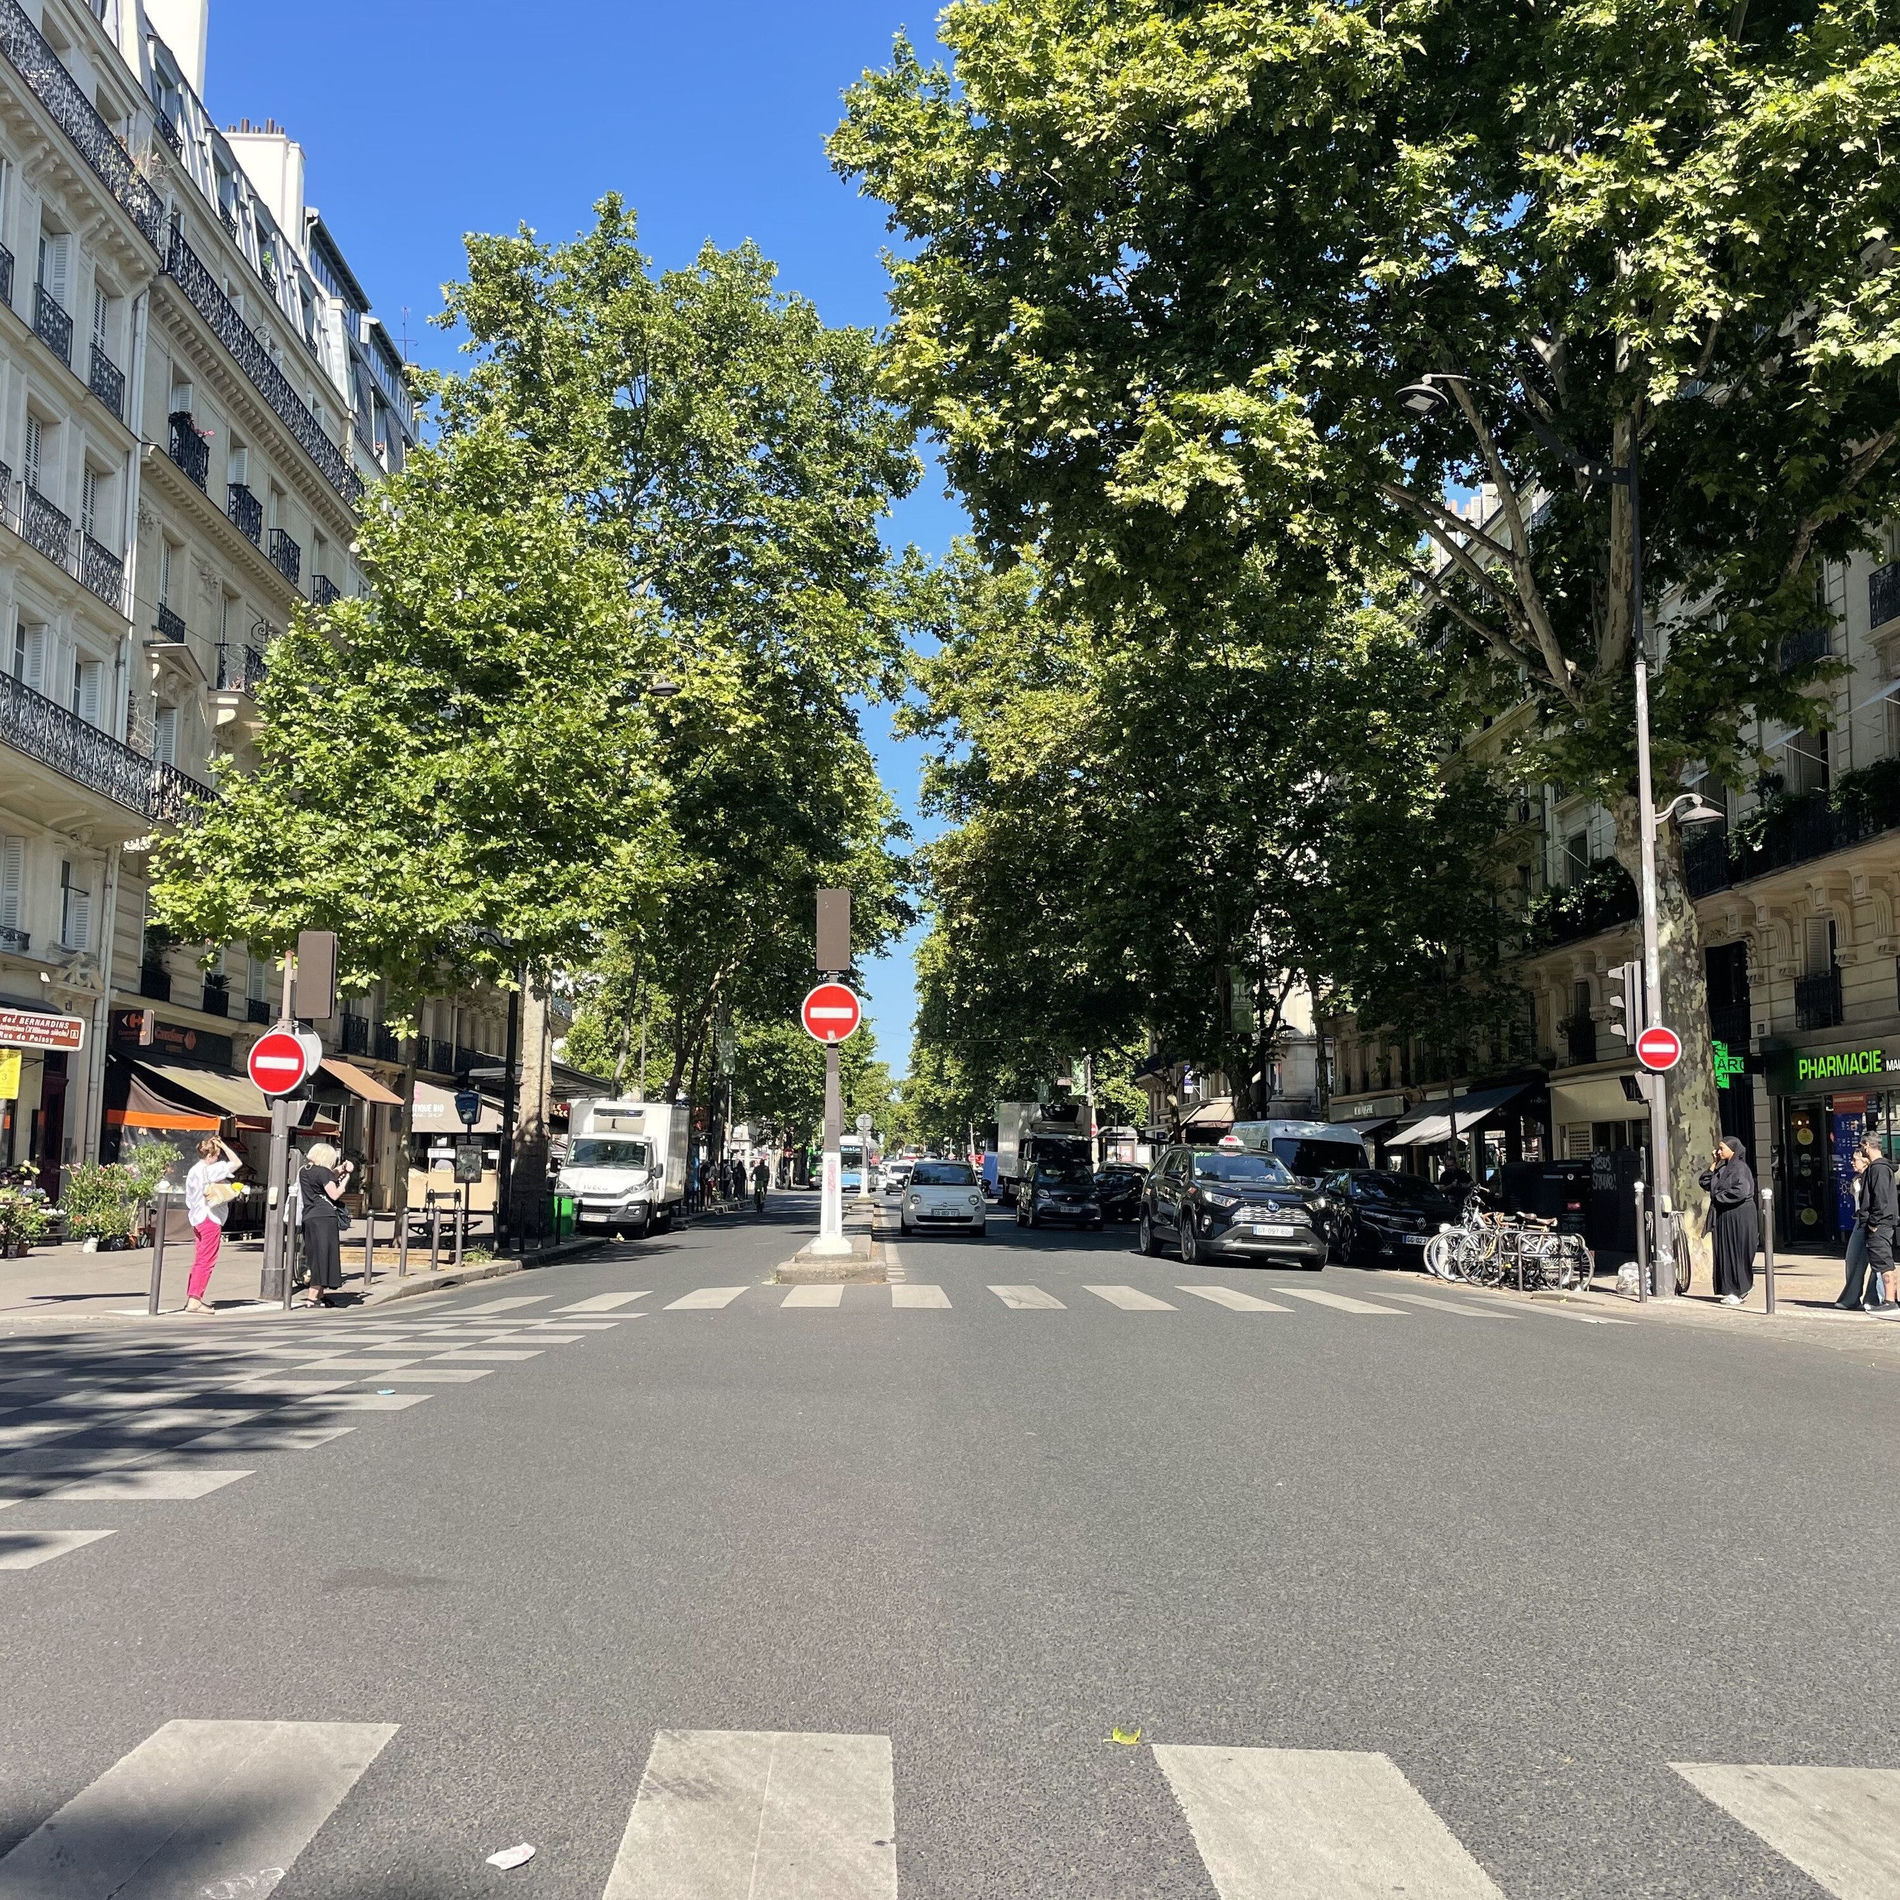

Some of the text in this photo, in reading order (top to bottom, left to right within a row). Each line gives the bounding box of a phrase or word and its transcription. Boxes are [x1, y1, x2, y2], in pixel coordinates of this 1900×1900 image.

[19, 1017, 70, 1030] BERNARDINS
[17, 1033, 26, 1041] de
[29, 1034, 54, 1046] Poissy
[1799, 1049, 1882, 1080] PHARMACIE
